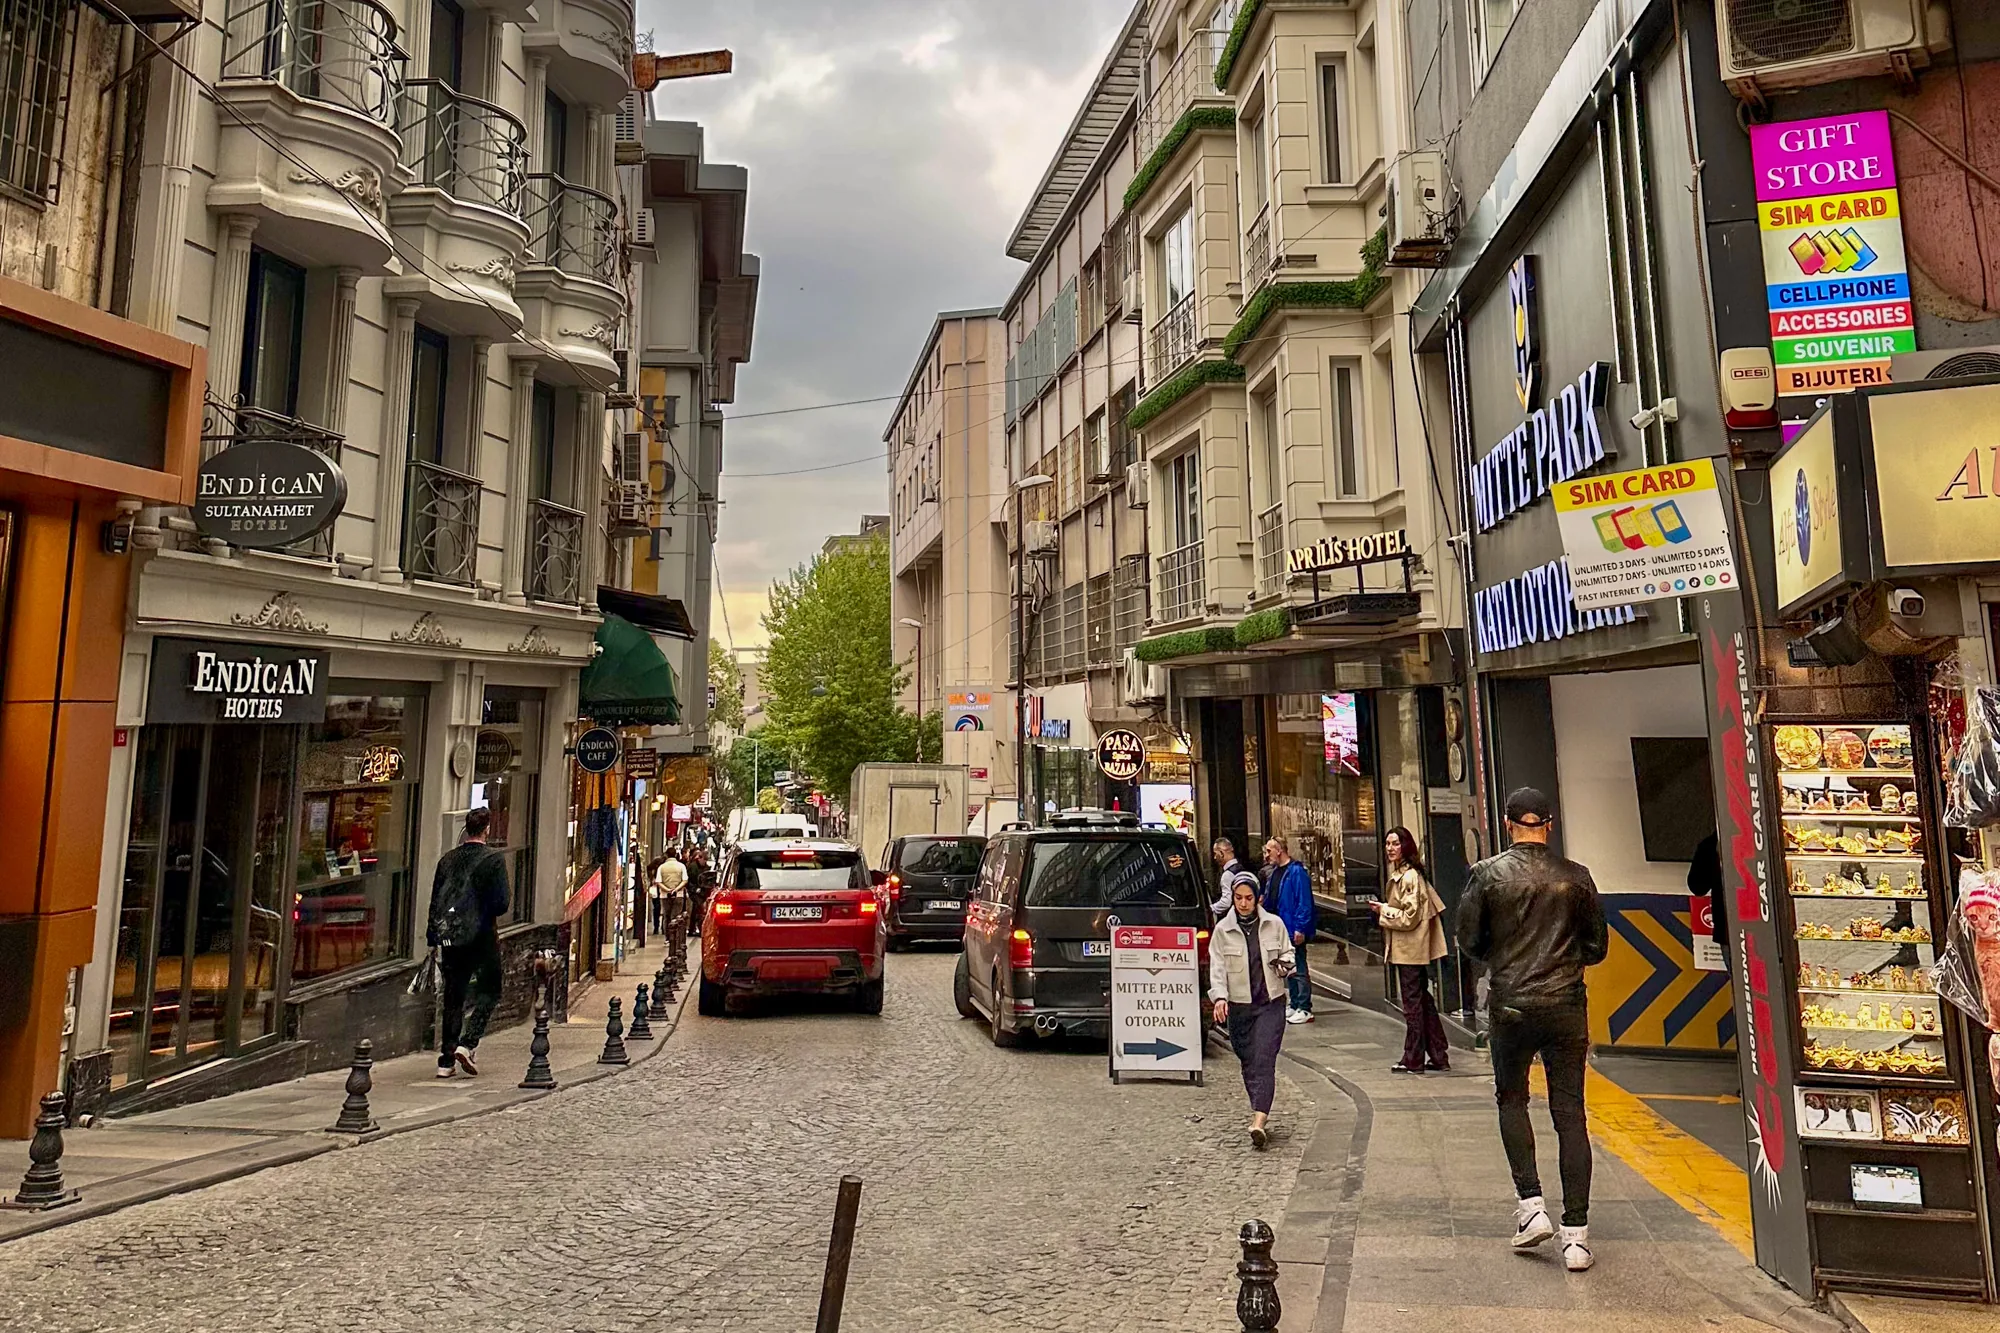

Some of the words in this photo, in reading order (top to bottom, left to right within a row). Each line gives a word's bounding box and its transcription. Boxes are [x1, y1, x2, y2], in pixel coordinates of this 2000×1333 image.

[1778, 121, 1860, 153] GIFT
[1767, 156, 1882, 190] STORE
[1770, 204, 1814, 226] SIM
[1820, 197, 1887, 220] CARD
[1779, 278, 1897, 304] CELLPHONE
[1777, 306, 1907, 332] ACCESSORIES
[1793, 336, 1896, 359] SOUVENIR
[1470, 420, 1532, 535] MITTE
[1532, 361, 1607, 498] PARK
[1569, 479, 1618, 505] SIM
[1622, 467, 1696, 496] CARD
[205, 504, 314, 518] SULTANAHMET
[1813, 473, 1837, 542] Style
[230, 519, 288, 531] HOTEL
[1347, 529, 1406, 562] HOTEL
[1574, 562, 1618, 576] UNLIMITED
[1619, 561, 1625, 569] 3
[1625, 557, 1646, 568] DAYS
[1651, 550, 1696, 564] UNLIMITED
[1697, 549, 1703, 557] 5
[1704, 545, 1726, 557] DAYS
[1574, 574, 1618, 588] UNLIMITED
[1620, 573, 1624, 582] 7
[1625, 570, 1647, 580] DAYS
[1651, 563, 1697, 577] UNLIMITED
[1699, 562, 1708, 571] 14
[1709, 557, 1730, 569] DAYS
[1578, 591, 1598, 602] FAST
[1600, 586, 1640, 599] INTERNET
[1474, 577, 1523, 655] KATLI
[224, 697, 283, 719] HOTELS
[1733, 631, 1756, 764] SYSTEMS
[587, 752, 607, 761] CAFE
[1104, 762, 1137, 776] BAZAAR
[1112, 751, 1131, 761] Spice
[1709, 624, 1761, 921] WAX
[1747, 769, 1764, 851] CARE
[1757, 856, 1770, 922] CAR
[776, 907, 787, 917] 34
[788, 907, 808, 917] KMC
[811, 907, 822, 917] 99
[1089, 944, 1101, 954] 34
[1116, 982, 1157, 994] MITTE
[1160, 983, 1193, 994] PARK
[1136, 999, 1174, 1011] KATLI
[1738, 928, 1760, 1076] PROFESSIONAL
[1125, 1015, 1186, 1028] OTOPARK
